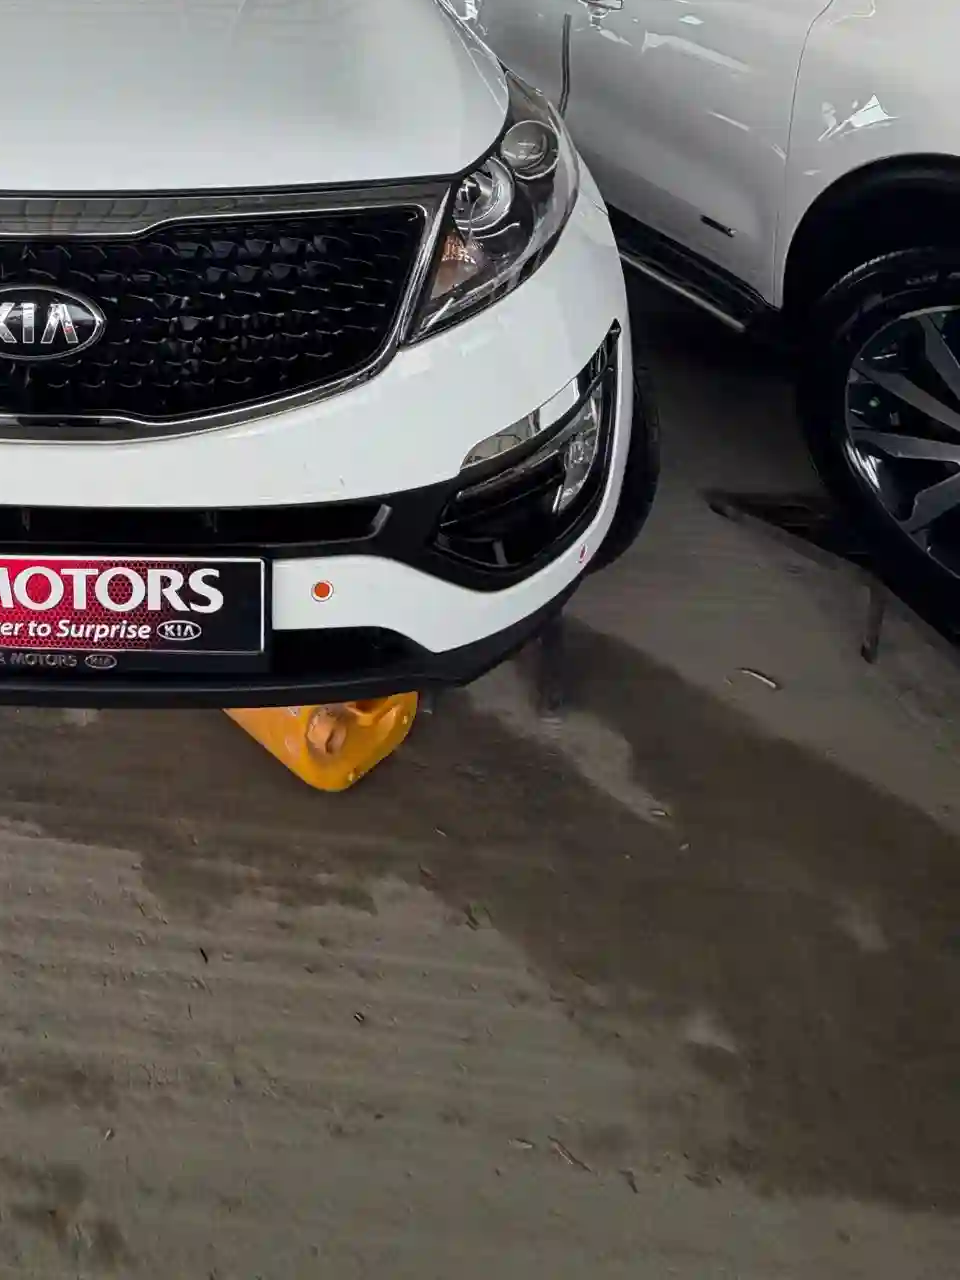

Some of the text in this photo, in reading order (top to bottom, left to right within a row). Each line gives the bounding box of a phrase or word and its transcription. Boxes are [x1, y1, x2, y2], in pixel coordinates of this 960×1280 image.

[28, 621, 52, 637] to
[56, 619, 152, 642] Surprise
[163, 623, 196, 637] KIA
[10, 652, 77, 667] MOTORS
